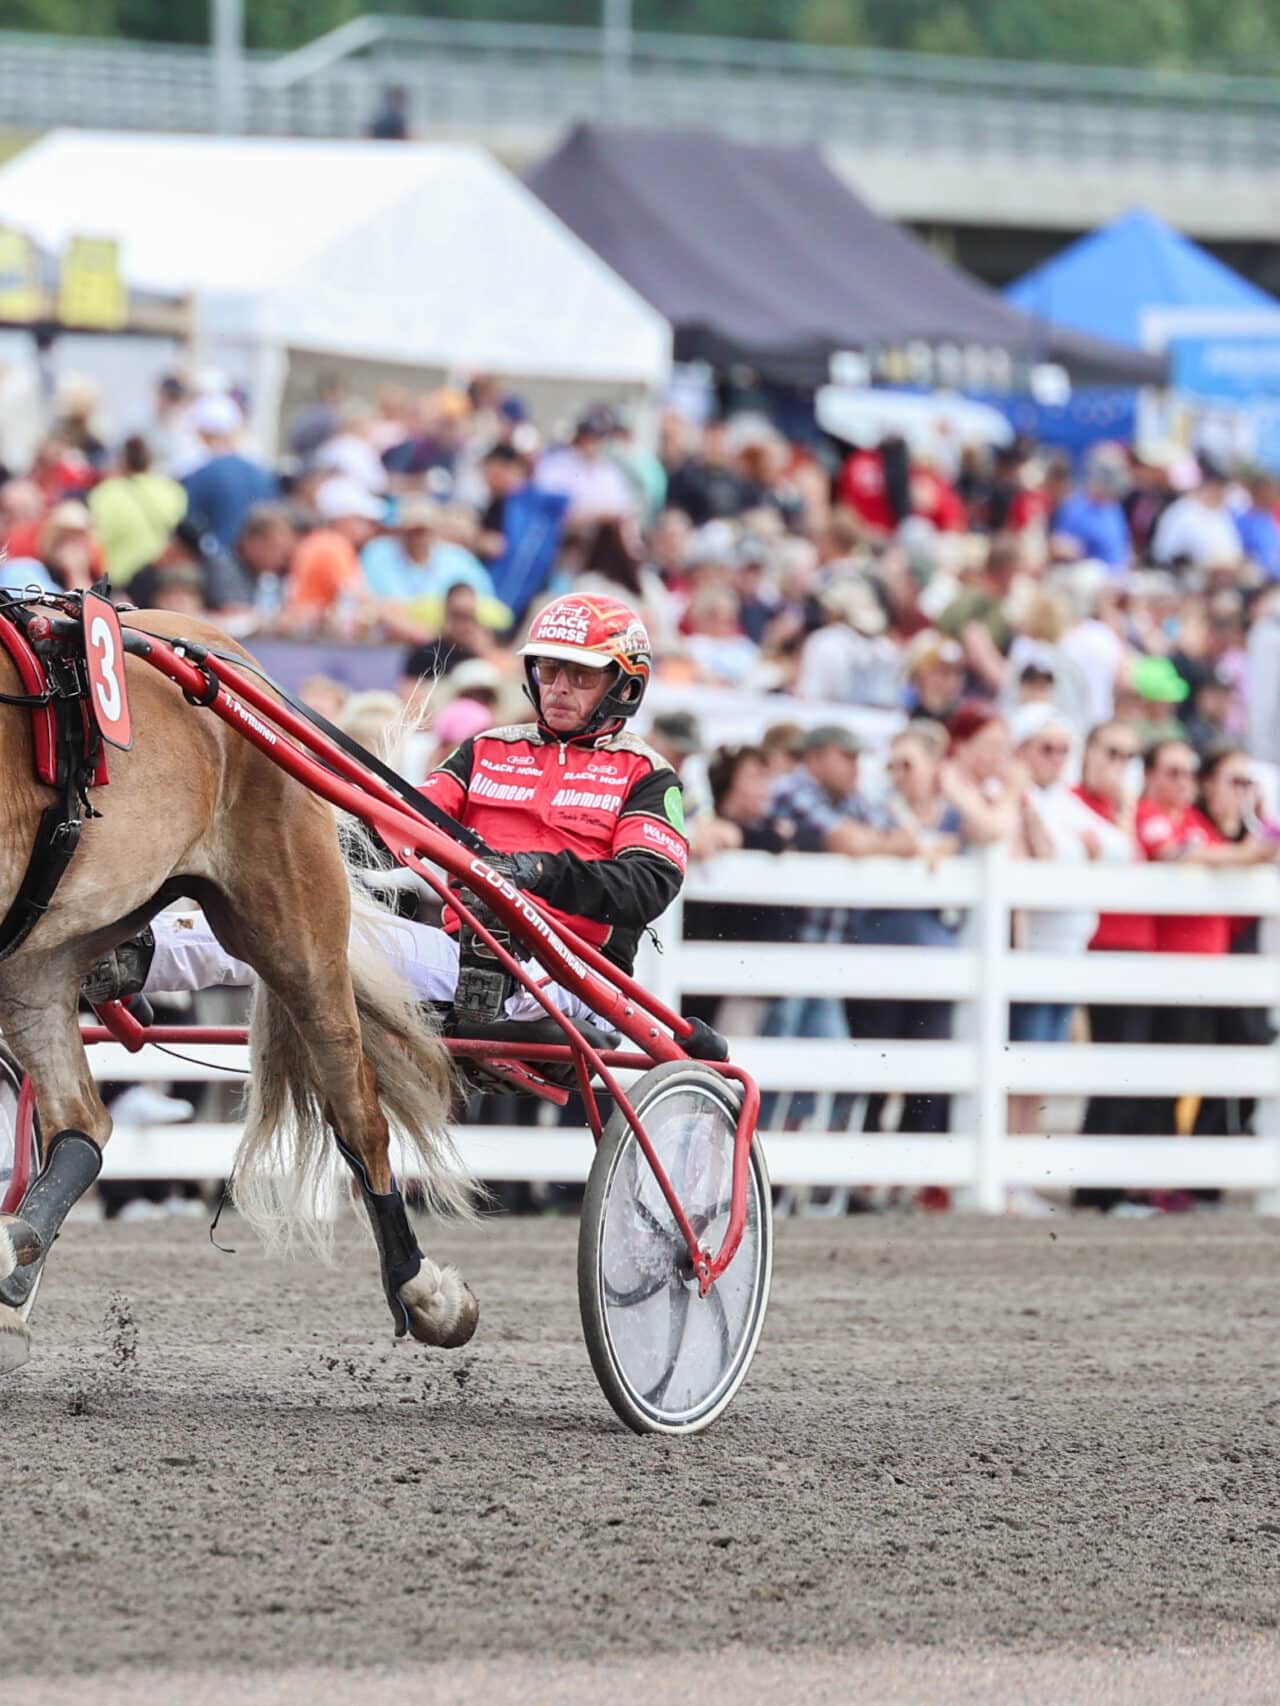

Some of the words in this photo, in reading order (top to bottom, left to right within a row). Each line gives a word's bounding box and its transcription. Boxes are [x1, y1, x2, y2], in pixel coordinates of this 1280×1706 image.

[541, 614, 590, 632] BLACK
[537, 626, 587, 644] HORSE
[91, 616, 122, 722] 3
[480, 759, 514, 773] BLACK
[563, 772, 597, 781] BLACK
